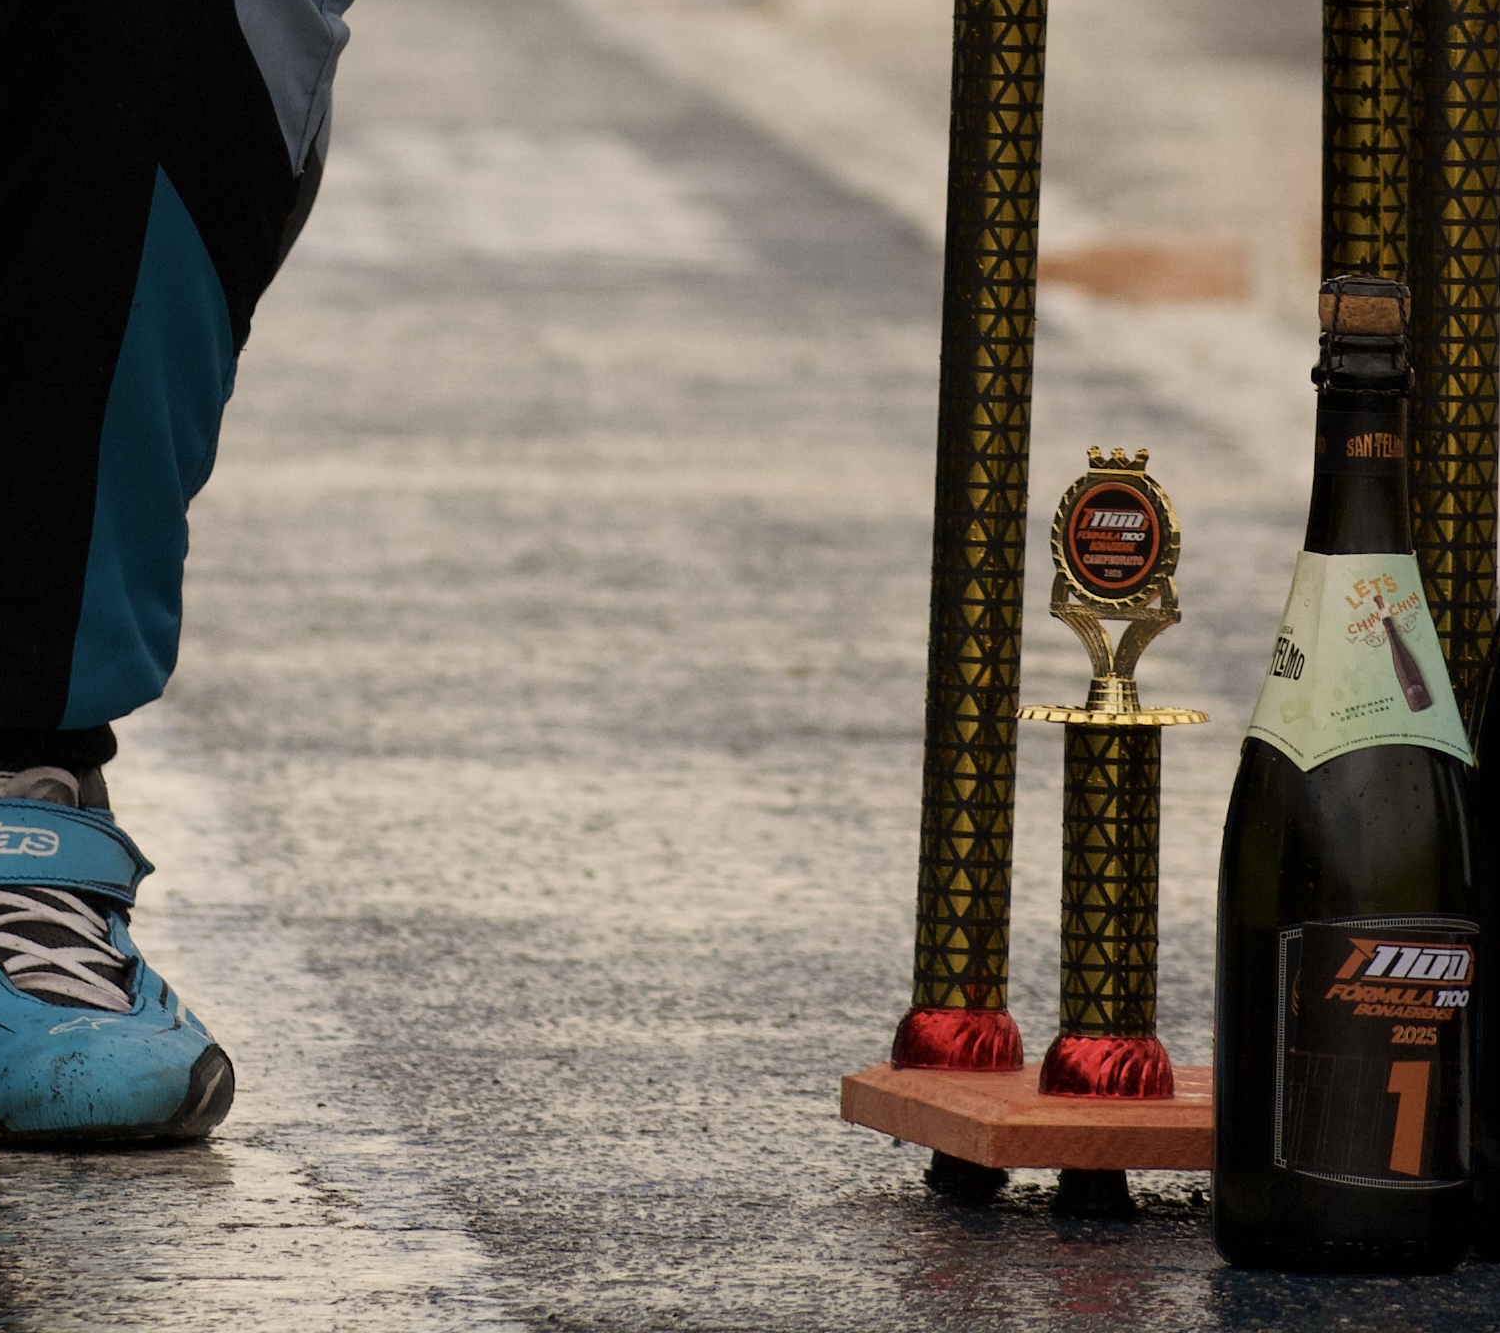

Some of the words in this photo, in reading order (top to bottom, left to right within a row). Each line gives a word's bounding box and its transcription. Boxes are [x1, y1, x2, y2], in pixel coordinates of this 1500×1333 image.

[1346, 433, 1373, 457] SAN
[1347, 612, 1382, 635] CHIN
[1389, 593, 1420, 618] CHIN
[1325, 982, 1433, 1006] FÓRMULA
[1435, 989, 1469, 1007] 1100
[1353, 1004, 1454, 1020] BONAERENSE
[1391, 1025, 1437, 1045] 2025
[1387, 1060, 1431, 1177] 1
